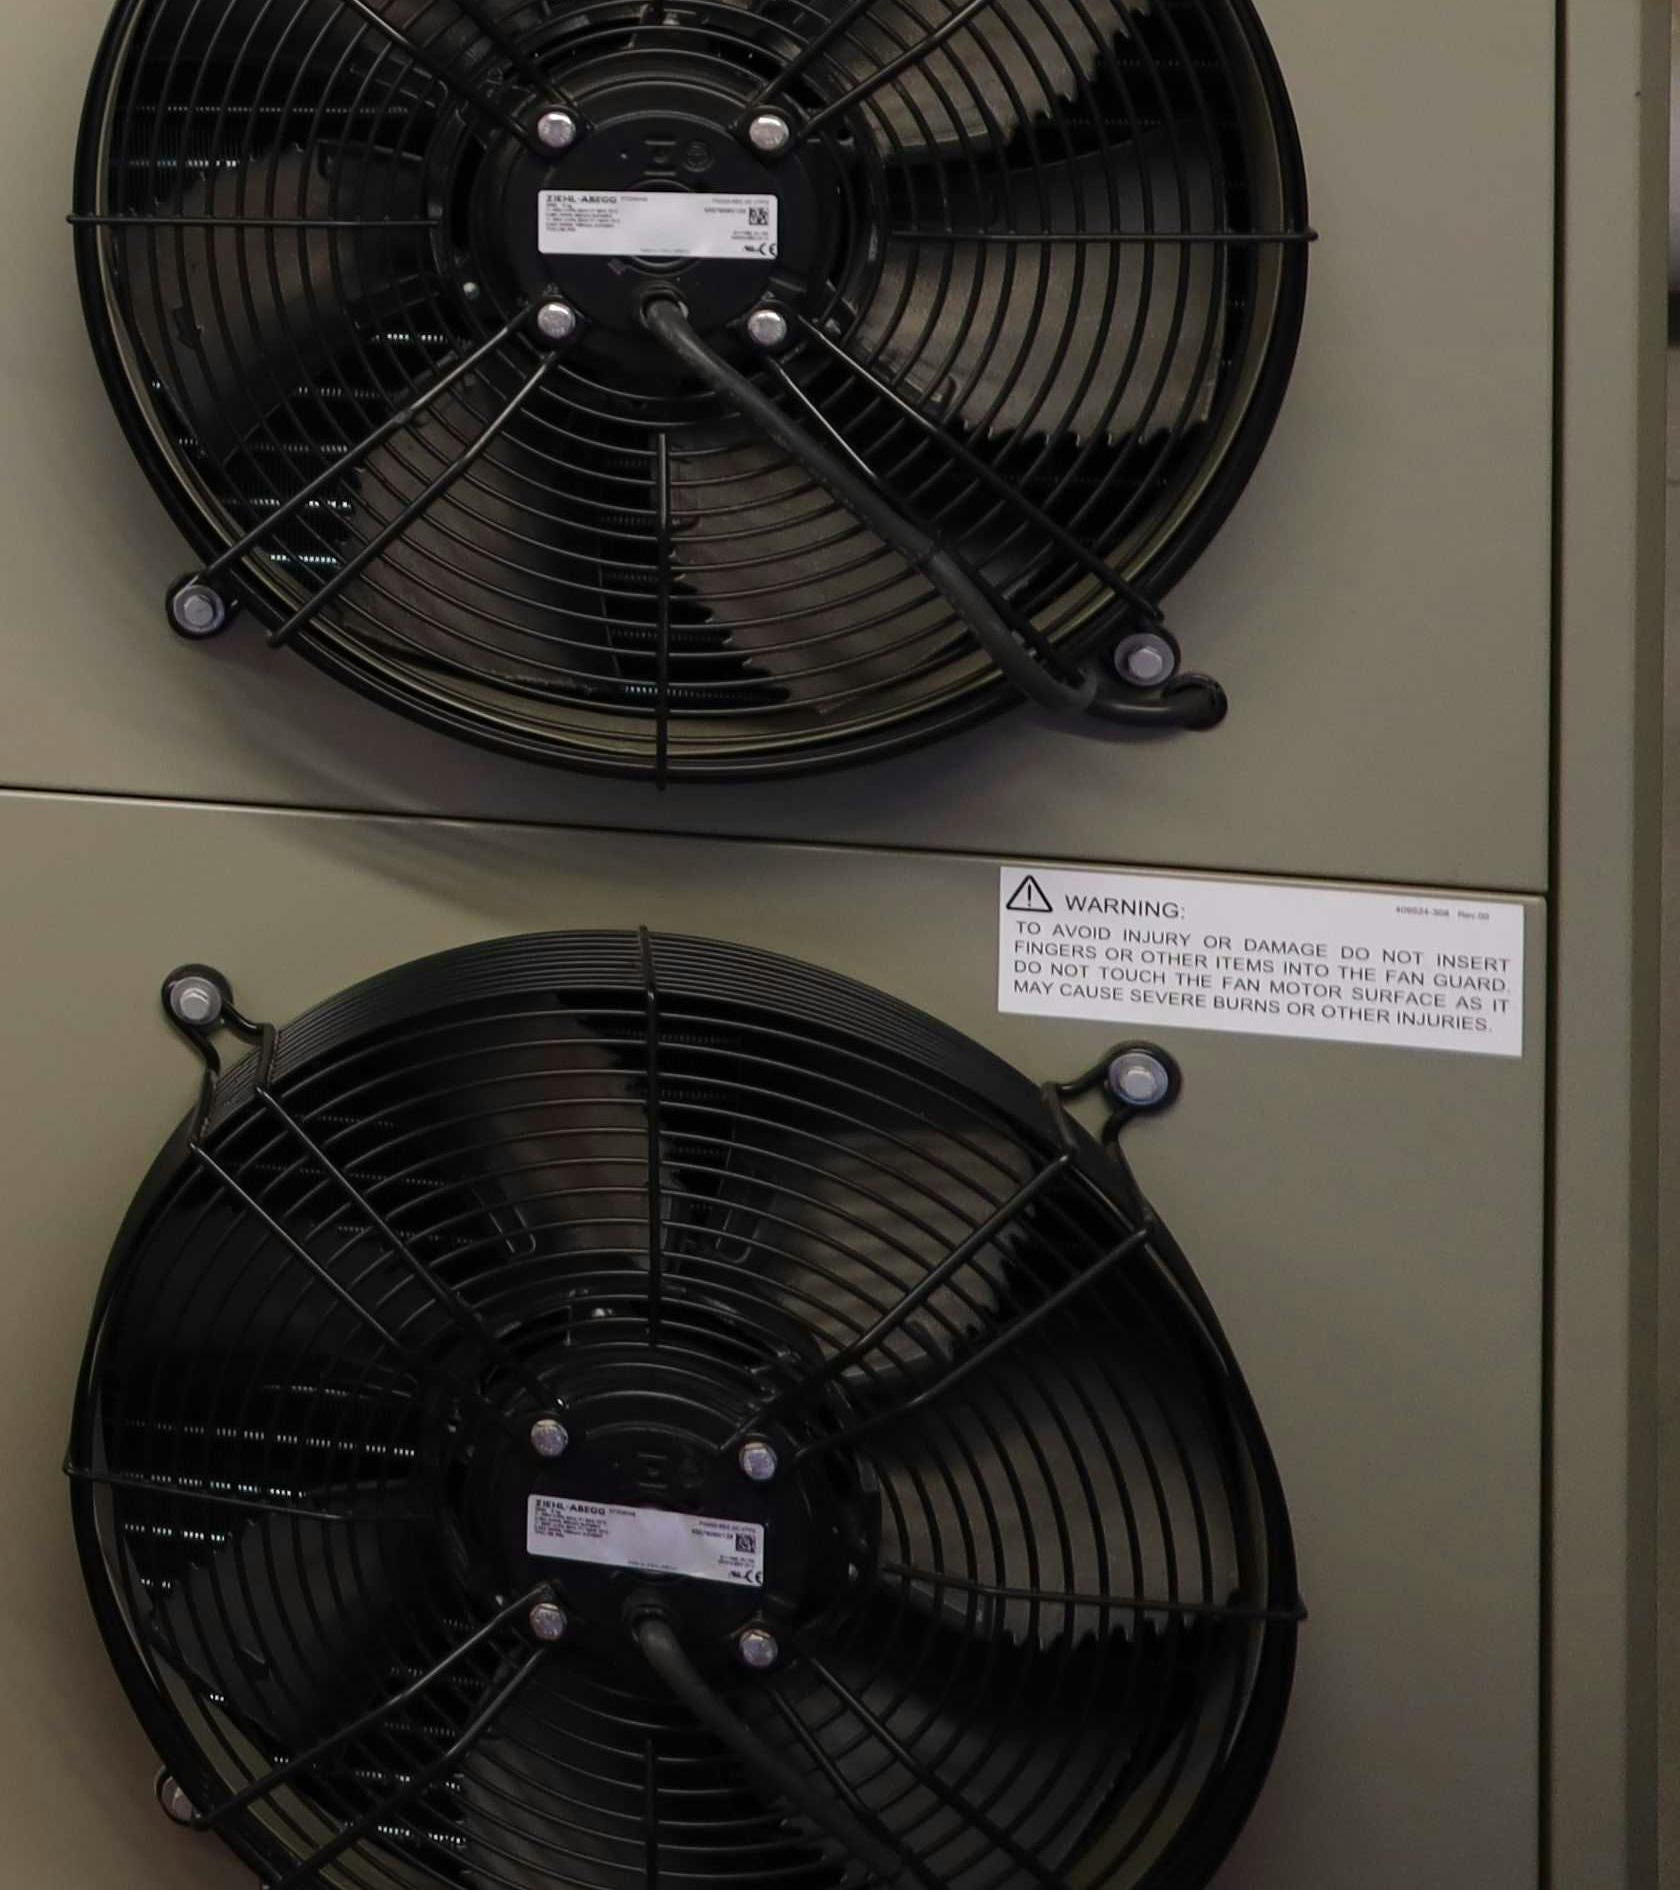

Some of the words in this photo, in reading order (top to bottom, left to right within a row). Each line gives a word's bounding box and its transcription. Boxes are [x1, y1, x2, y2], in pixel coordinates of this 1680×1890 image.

[1064, 894, 1187, 920] WARNING:
[1014, 939, 1097, 959] FINGERS
[1105, 947, 1133, 962] OR
[1141, 950, 1208, 969] OTHER
[1216, 956, 1274, 973] ITEMS
[1283, 962, 1329, 978] INTO
[1338, 966, 1377, 982] THE
[1386, 969, 1425, 987] FAN
[1015, 920, 1041, 936] TO
[1052, 924, 1111, 940] AVOID
[1123, 929, 1191, 947] INJURY
[1203, 935, 1232, 951] OR
[1244, 938, 1328, 958] DAMAGE
[1340, 945, 1370, 960] DO
[1382, 949, 1425, 966] NOT
[1437, 953, 1511, 972] INSERT
[1014, 959, 1042, 975] DO
[1051, 963, 1090, 979] NOT
[1098, 966, 1166, 986] TOUCH
[1174, 972, 1212, 988] THE
[1222, 976, 1260, 992] FAN
[1269, 980, 1342, 999] MOTOR
[1352, 986, 1446, 1008] SURFACE
[1455, 995, 1483, 1011] AS
[1493, 998, 1511, 1013] IT
[1014, 979, 1054, 995] MAY
[1059, 982, 1126, 1001] CAUSE
[1129, 988, 1207, 1008] SEVERE
[1213, 994, 1280, 1014] BURNS
[1286, 1001, 1316, 1017] OR
[1321, 1004, 1390, 1024] OTHER
